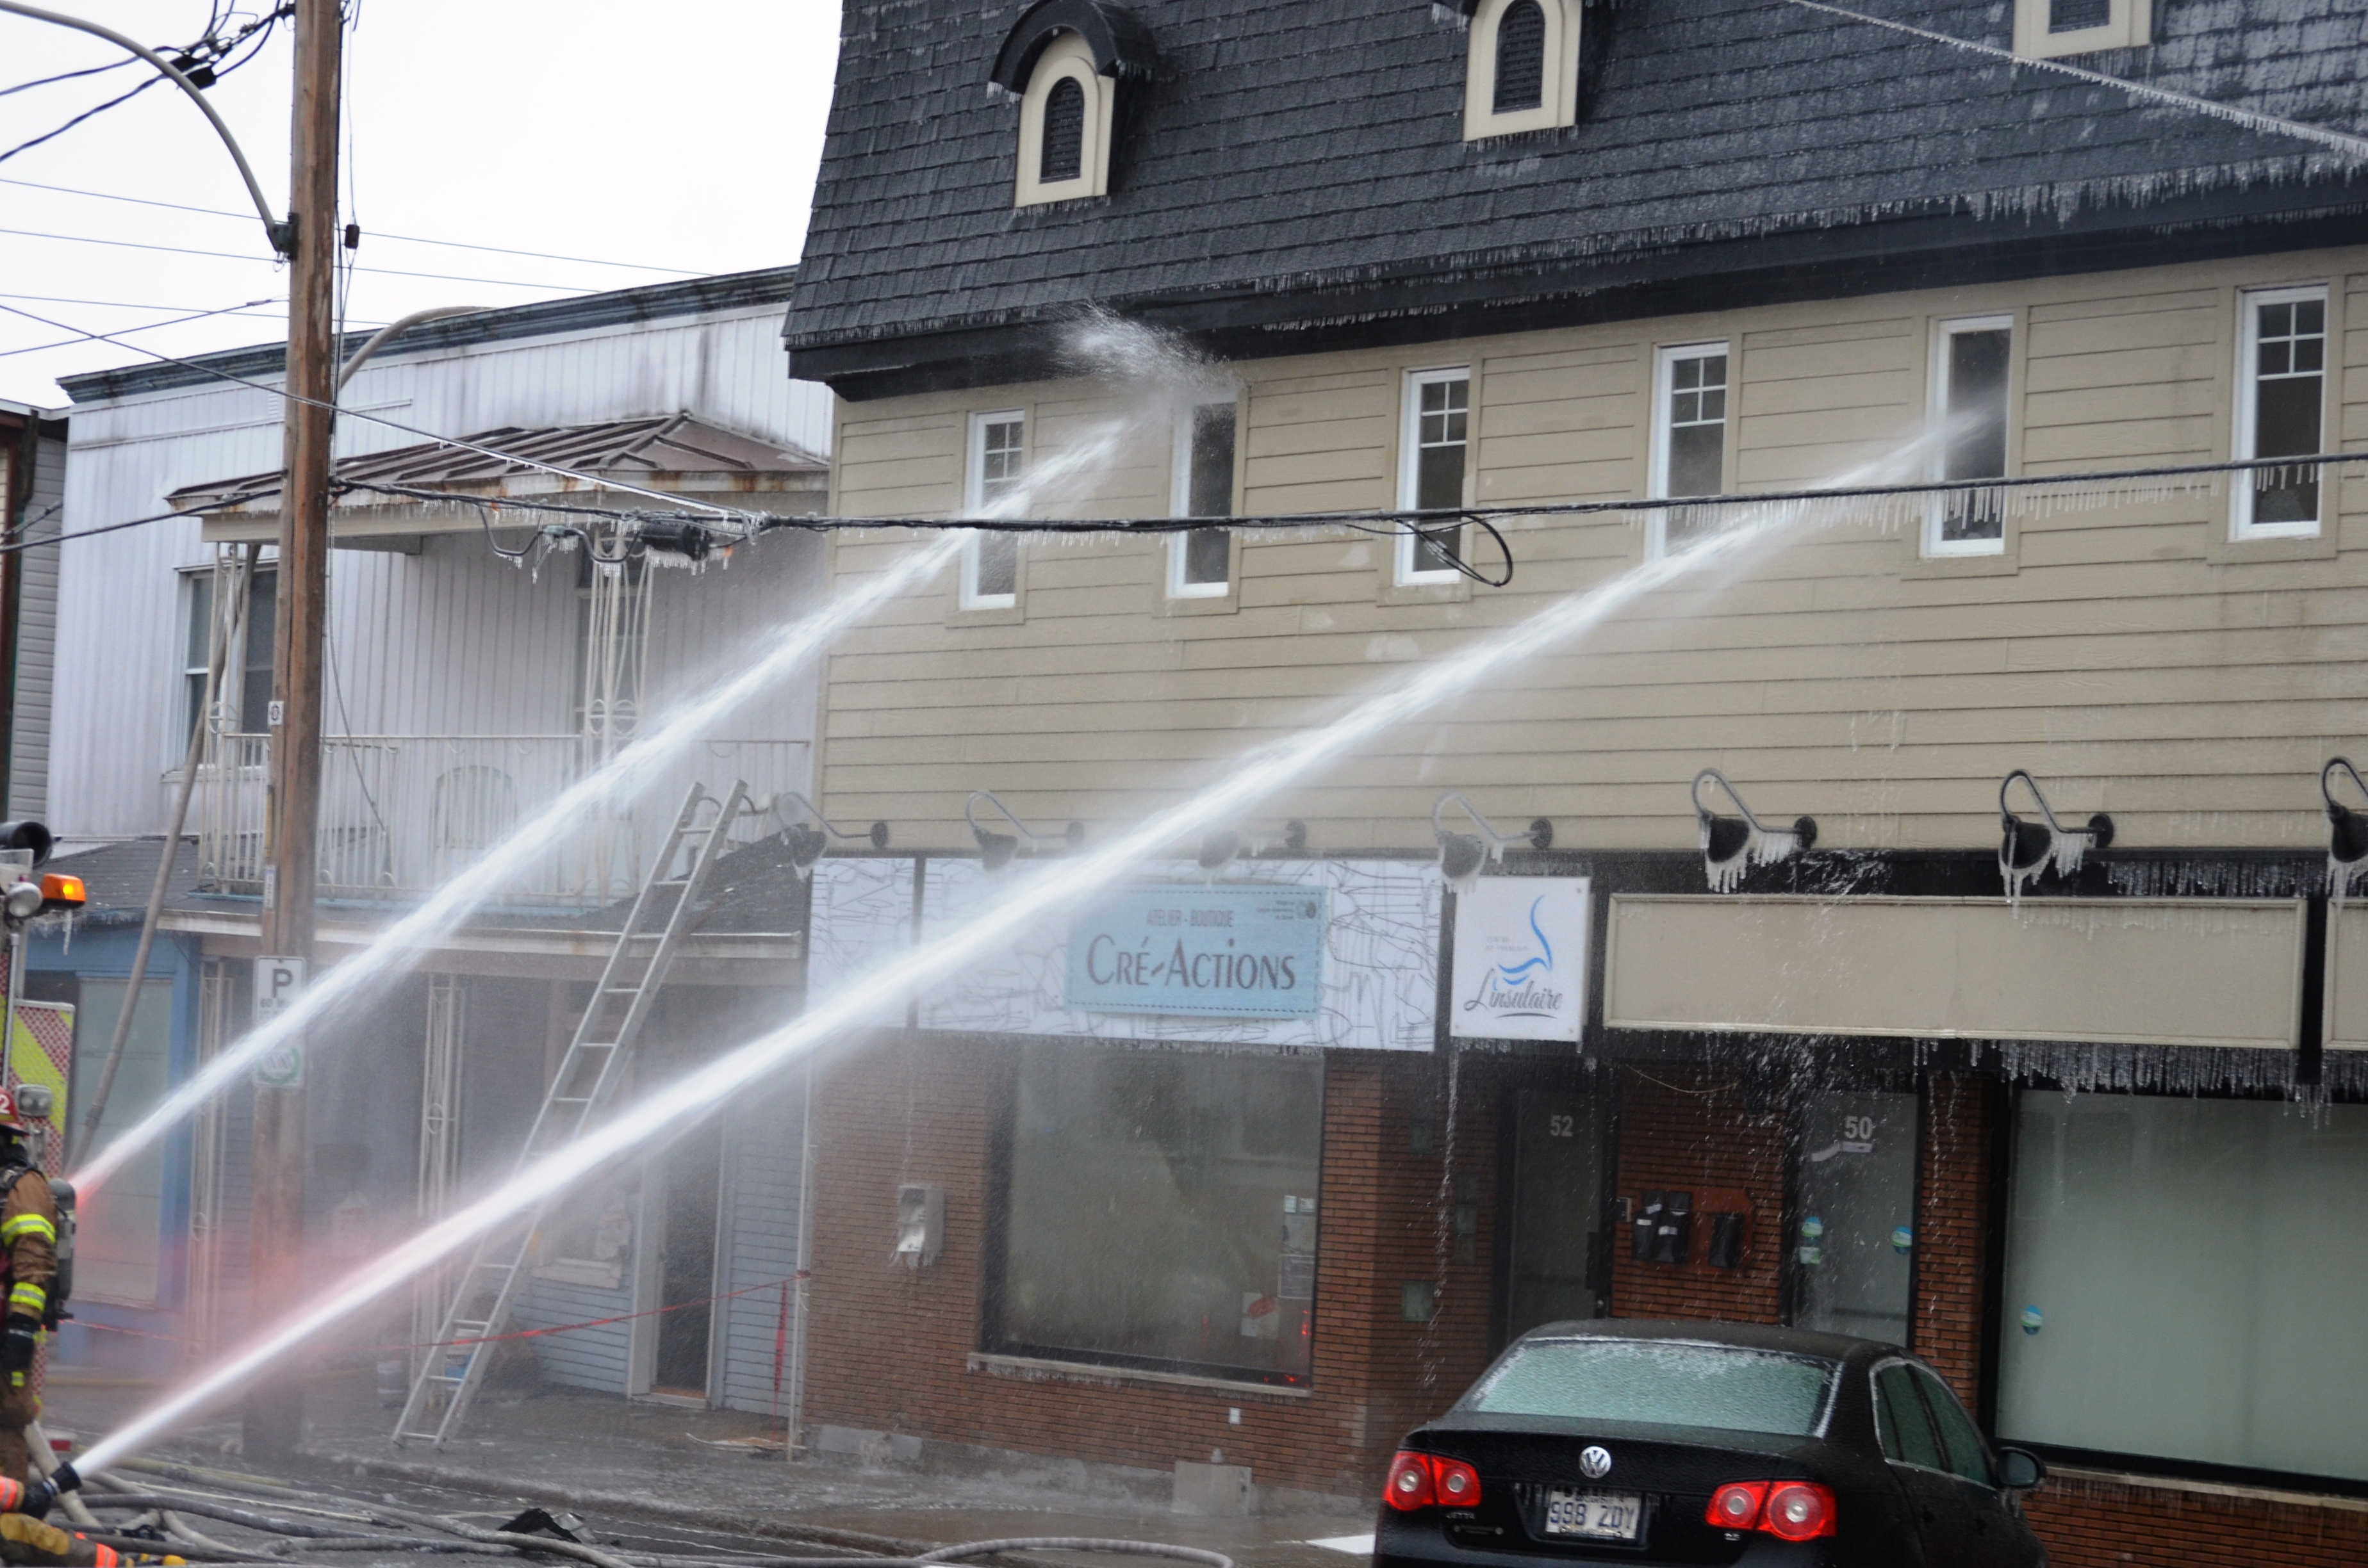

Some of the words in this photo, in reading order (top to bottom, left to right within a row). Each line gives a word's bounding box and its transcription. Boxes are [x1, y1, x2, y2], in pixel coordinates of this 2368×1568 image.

[273, 968, 293, 999] P
[1550, 1115, 1574, 1137] 52
[1845, 1116, 1872, 1139] 50
